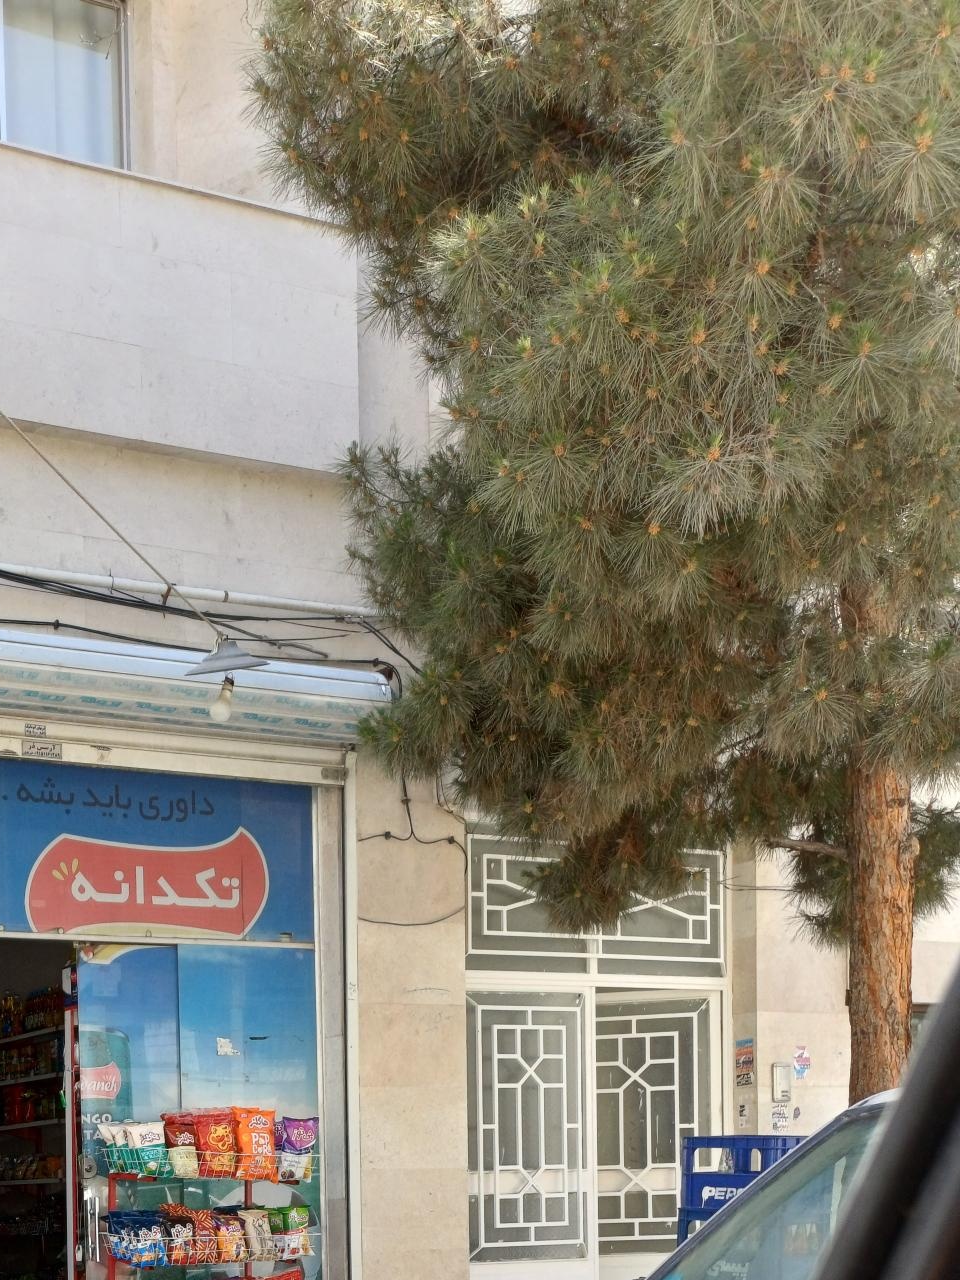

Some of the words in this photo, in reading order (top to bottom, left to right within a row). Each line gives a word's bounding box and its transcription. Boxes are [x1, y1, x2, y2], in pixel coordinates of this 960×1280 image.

[16, 777, 75, 814] بشه
[82, 785, 132, 817] باید
[139, 790, 215, 821] داوری
[71, 866, 240, 908] تکدانه
